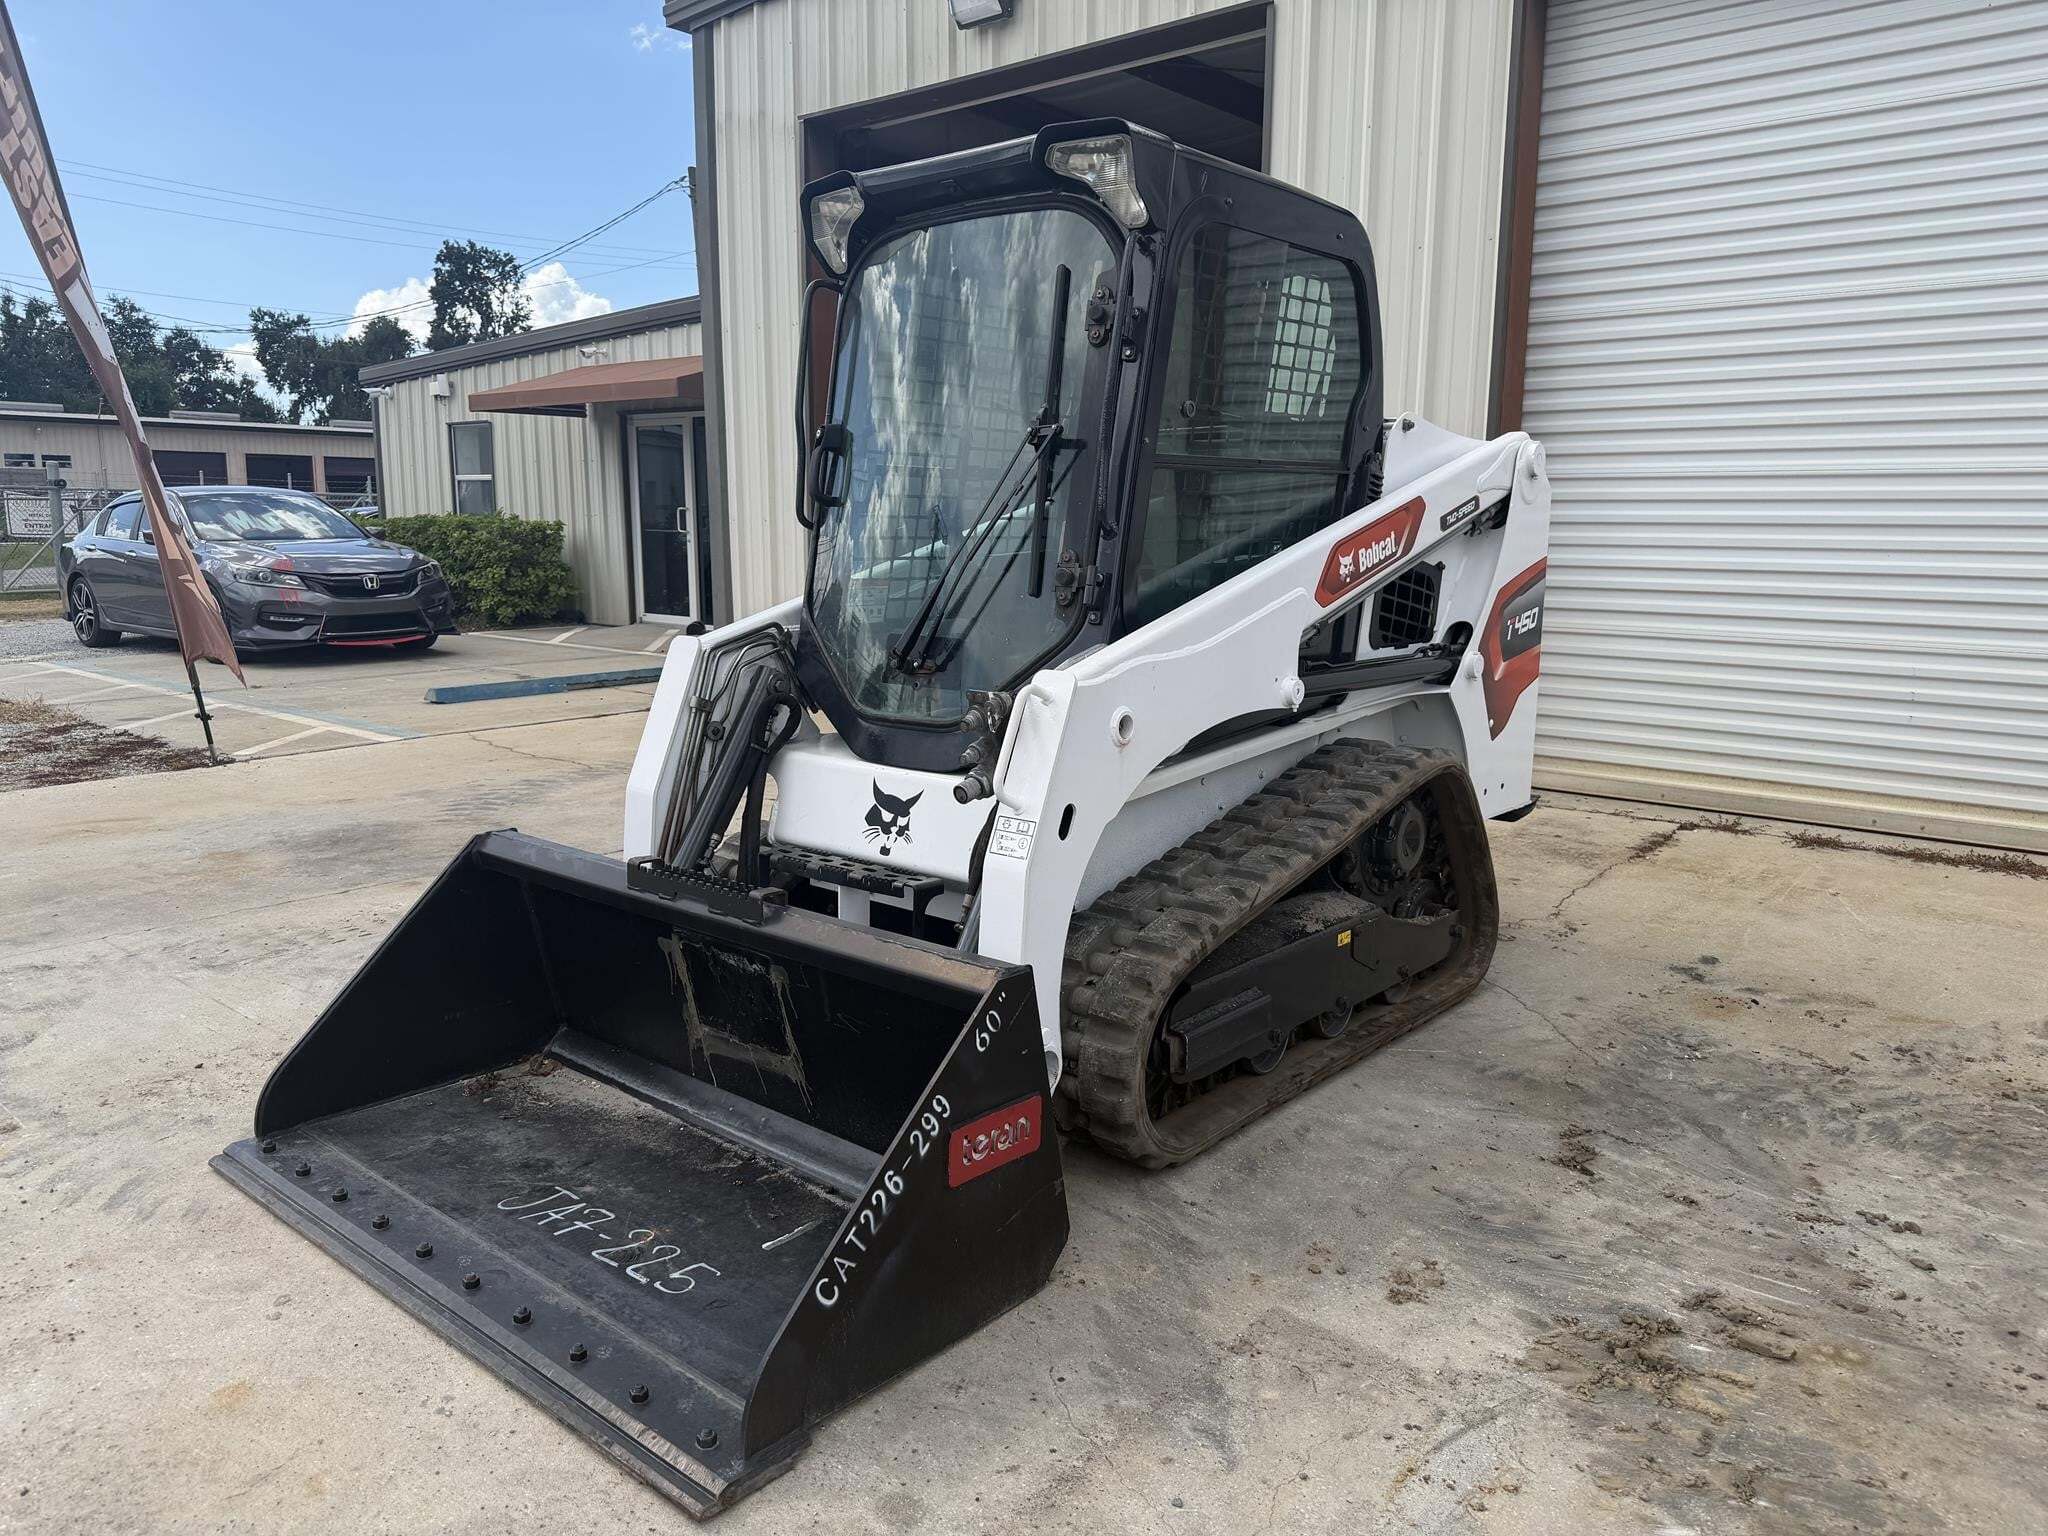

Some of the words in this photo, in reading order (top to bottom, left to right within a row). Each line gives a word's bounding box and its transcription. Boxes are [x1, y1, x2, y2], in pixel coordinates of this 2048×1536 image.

[1446, 500, 1476, 526] TWO-SPEED
[1358, 530, 1397, 573] Bobcat
[1507, 606, 1539, 641] T450
[976, 991, 1006, 1052] 60"
[962, 1116, 1031, 1167] teran
